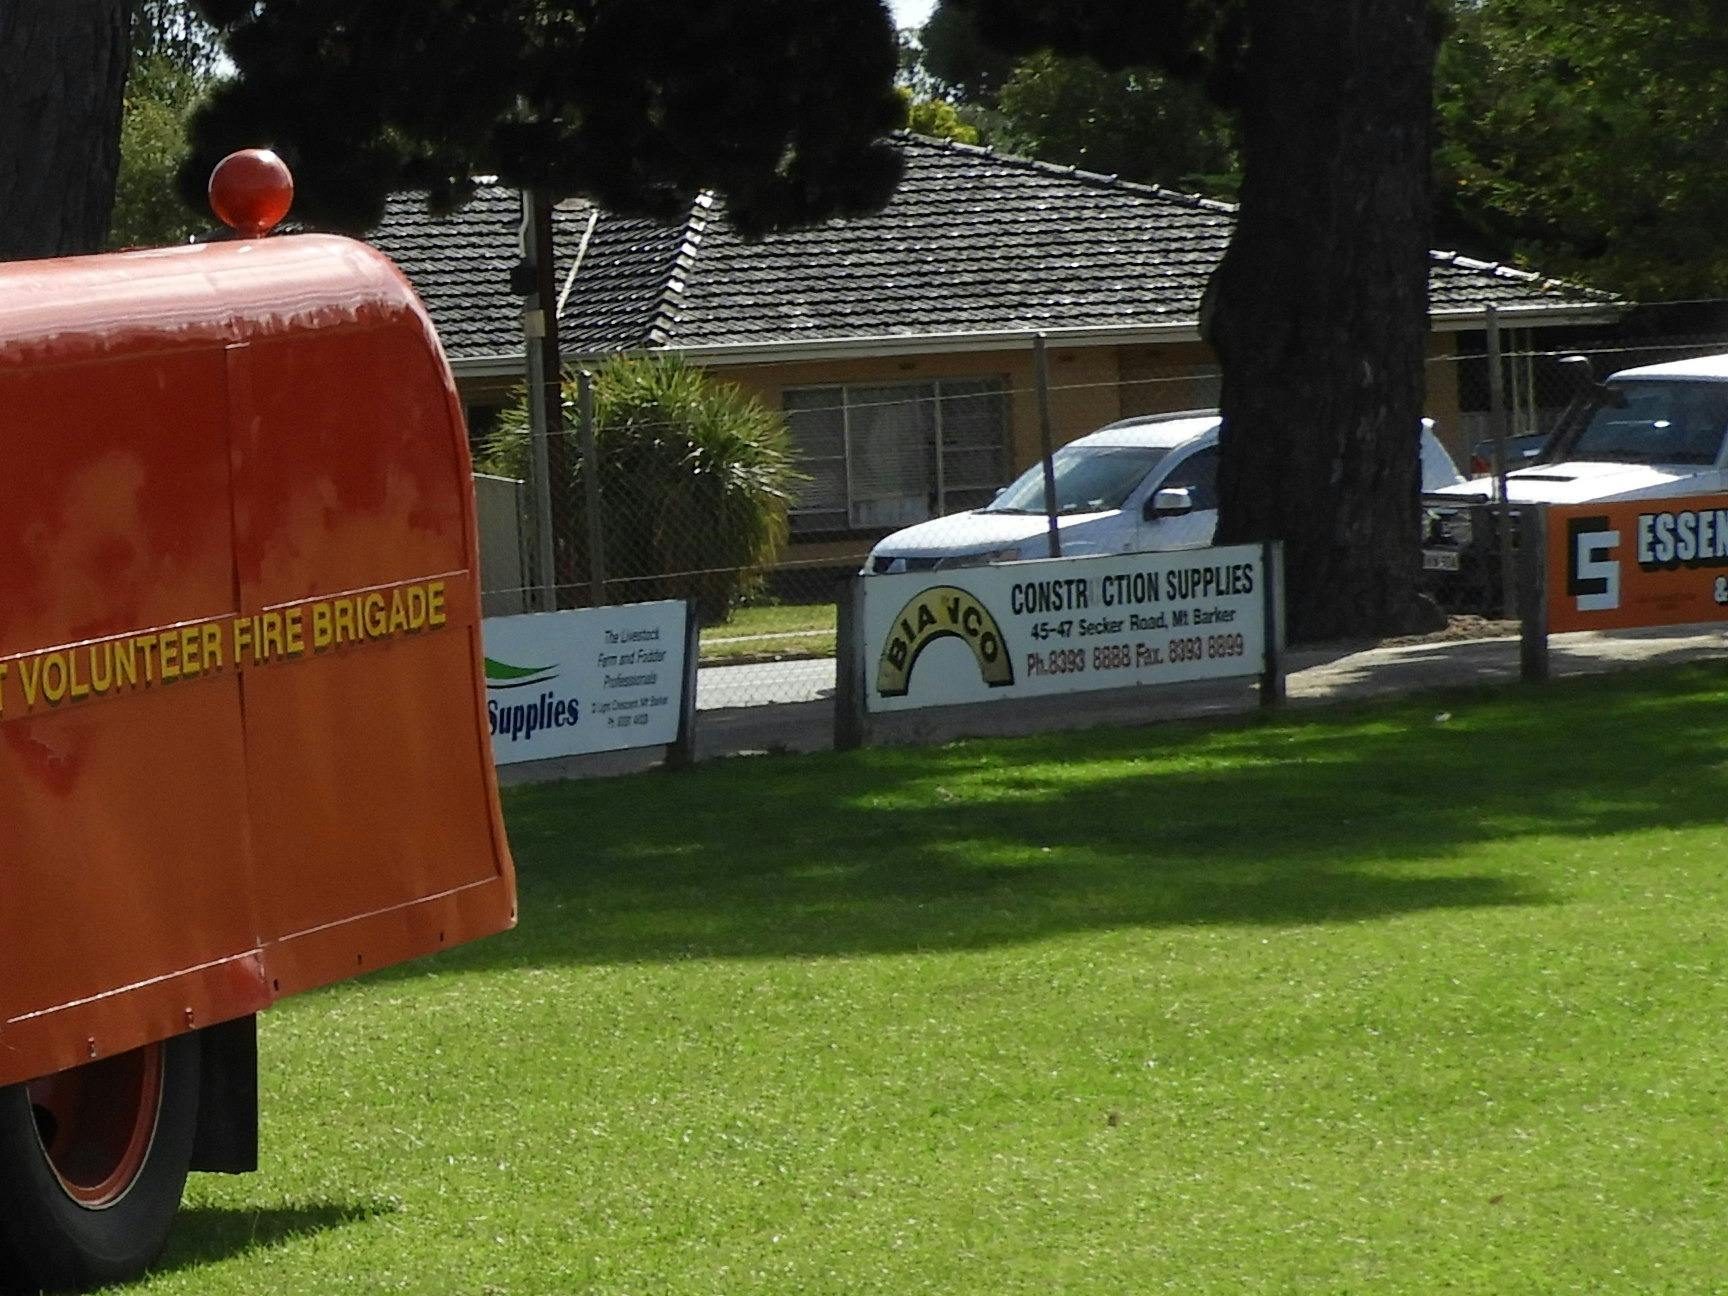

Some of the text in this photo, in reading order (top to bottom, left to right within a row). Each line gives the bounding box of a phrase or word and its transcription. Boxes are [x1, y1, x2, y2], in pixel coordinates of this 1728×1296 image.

[1166, 563, 1254, 602] SUPPLIES
[19, 623, 223, 706] VOLUNTEER
[234, 607, 304, 664] FIRE
[313, 582, 447, 649] BRIGADE
[1030, 607, 1236, 640] 45-47 Secker Road, Mt Barker
[488, 691, 579, 742] Supplies
